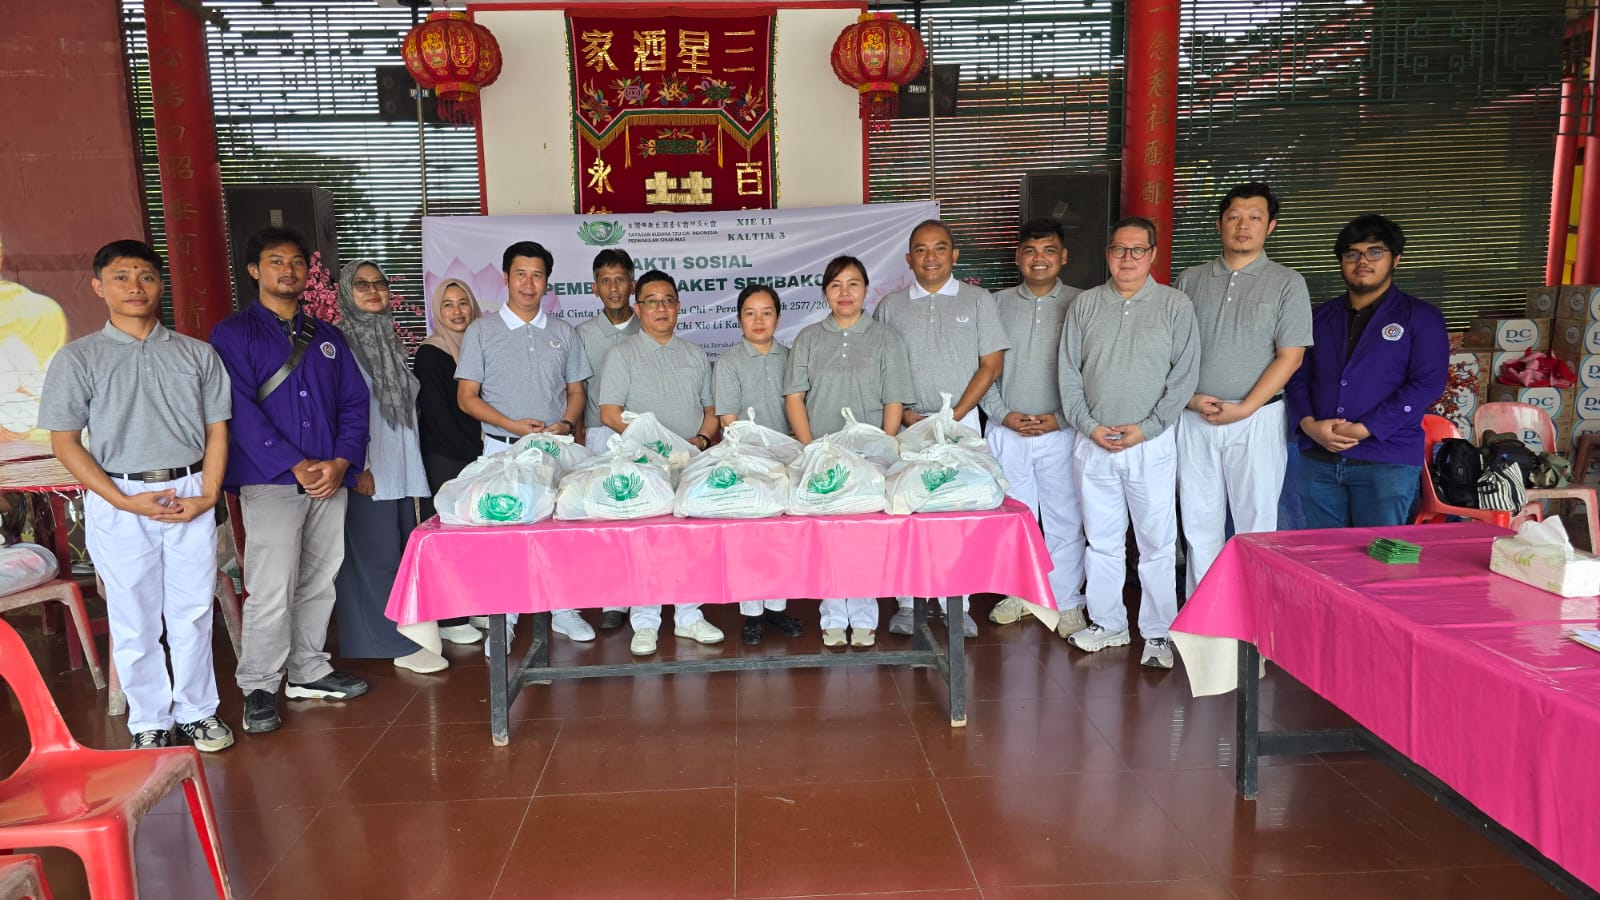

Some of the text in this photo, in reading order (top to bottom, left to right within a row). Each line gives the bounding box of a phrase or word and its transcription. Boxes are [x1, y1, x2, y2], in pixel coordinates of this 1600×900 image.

[736, 217, 774, 226] XIE LI
[727, 231, 786, 241] KALTIM 3
[632, 255, 753, 272] AKTI SOSIAL
[544, 281, 595, 297] PEMB
[677, 278, 728, 293] AKET
[689, 305, 706, 315] Chi
[716, 305, 738, 315] Pera
[790, 300, 829, 312] 2577/20
[566, 308, 595, 319] Cinta
[694, 320, 711, 330] Xie
[713, 319, 722, 329] Li
[1505, 329, 1532, 339] DC
